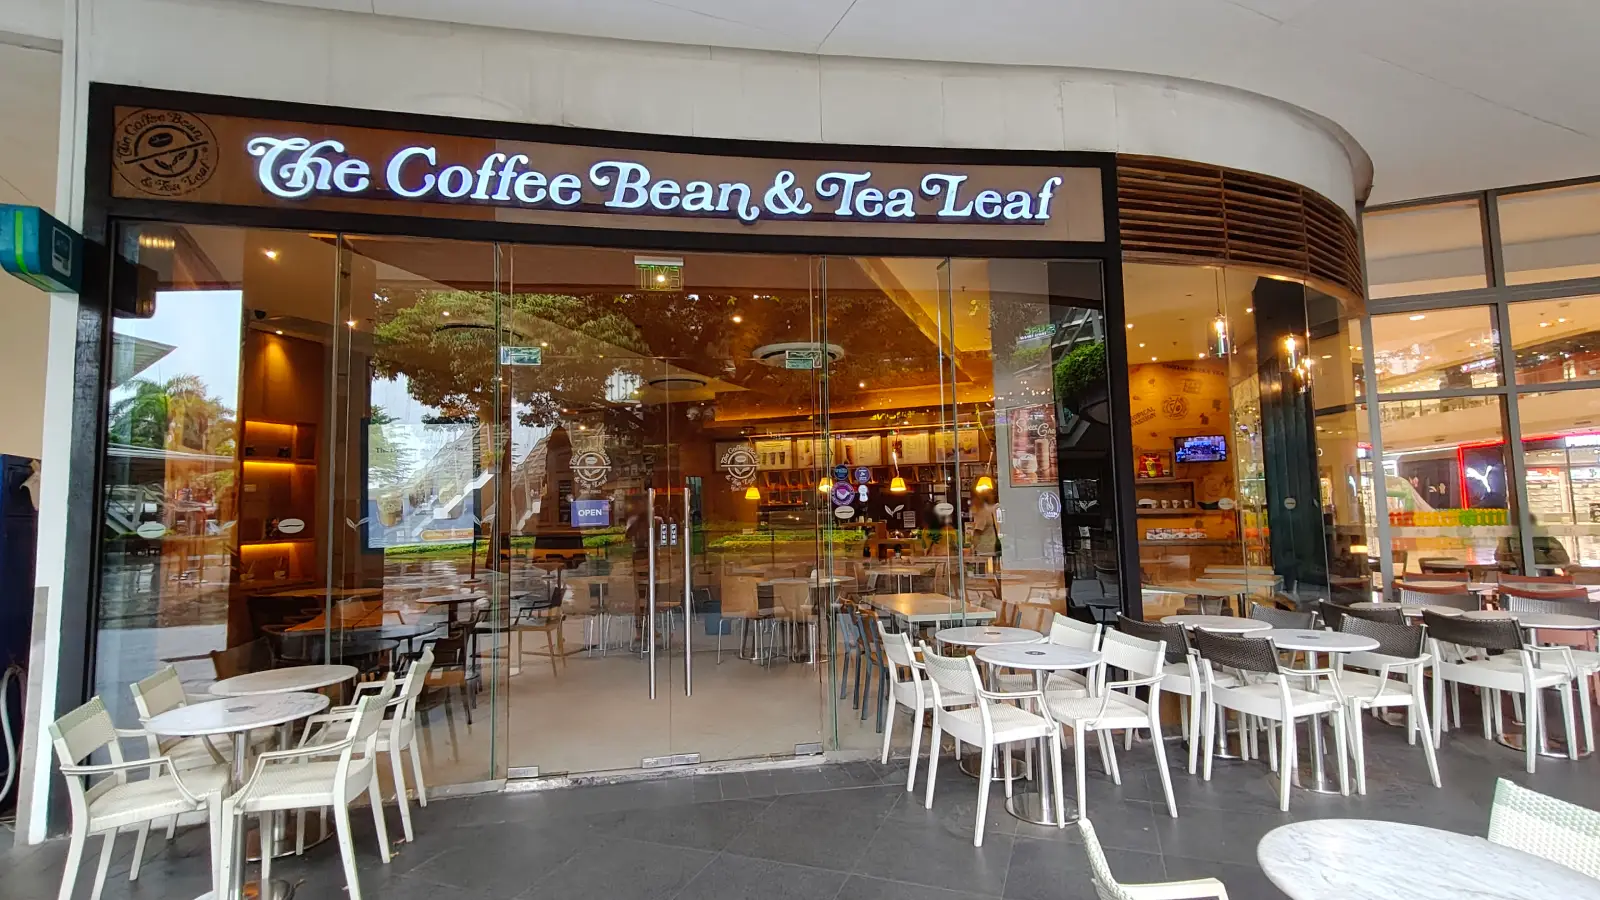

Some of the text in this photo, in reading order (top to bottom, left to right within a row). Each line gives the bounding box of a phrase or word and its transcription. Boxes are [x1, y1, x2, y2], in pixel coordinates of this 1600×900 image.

[124, 112, 166, 136] Coffee
[167, 112, 204, 141] Bean
[181, 158, 210, 186] Leaf
[246, 136, 1064, 221] The Coffee Bean & Tea Leaf
[578, 509, 602, 517] OPEN
